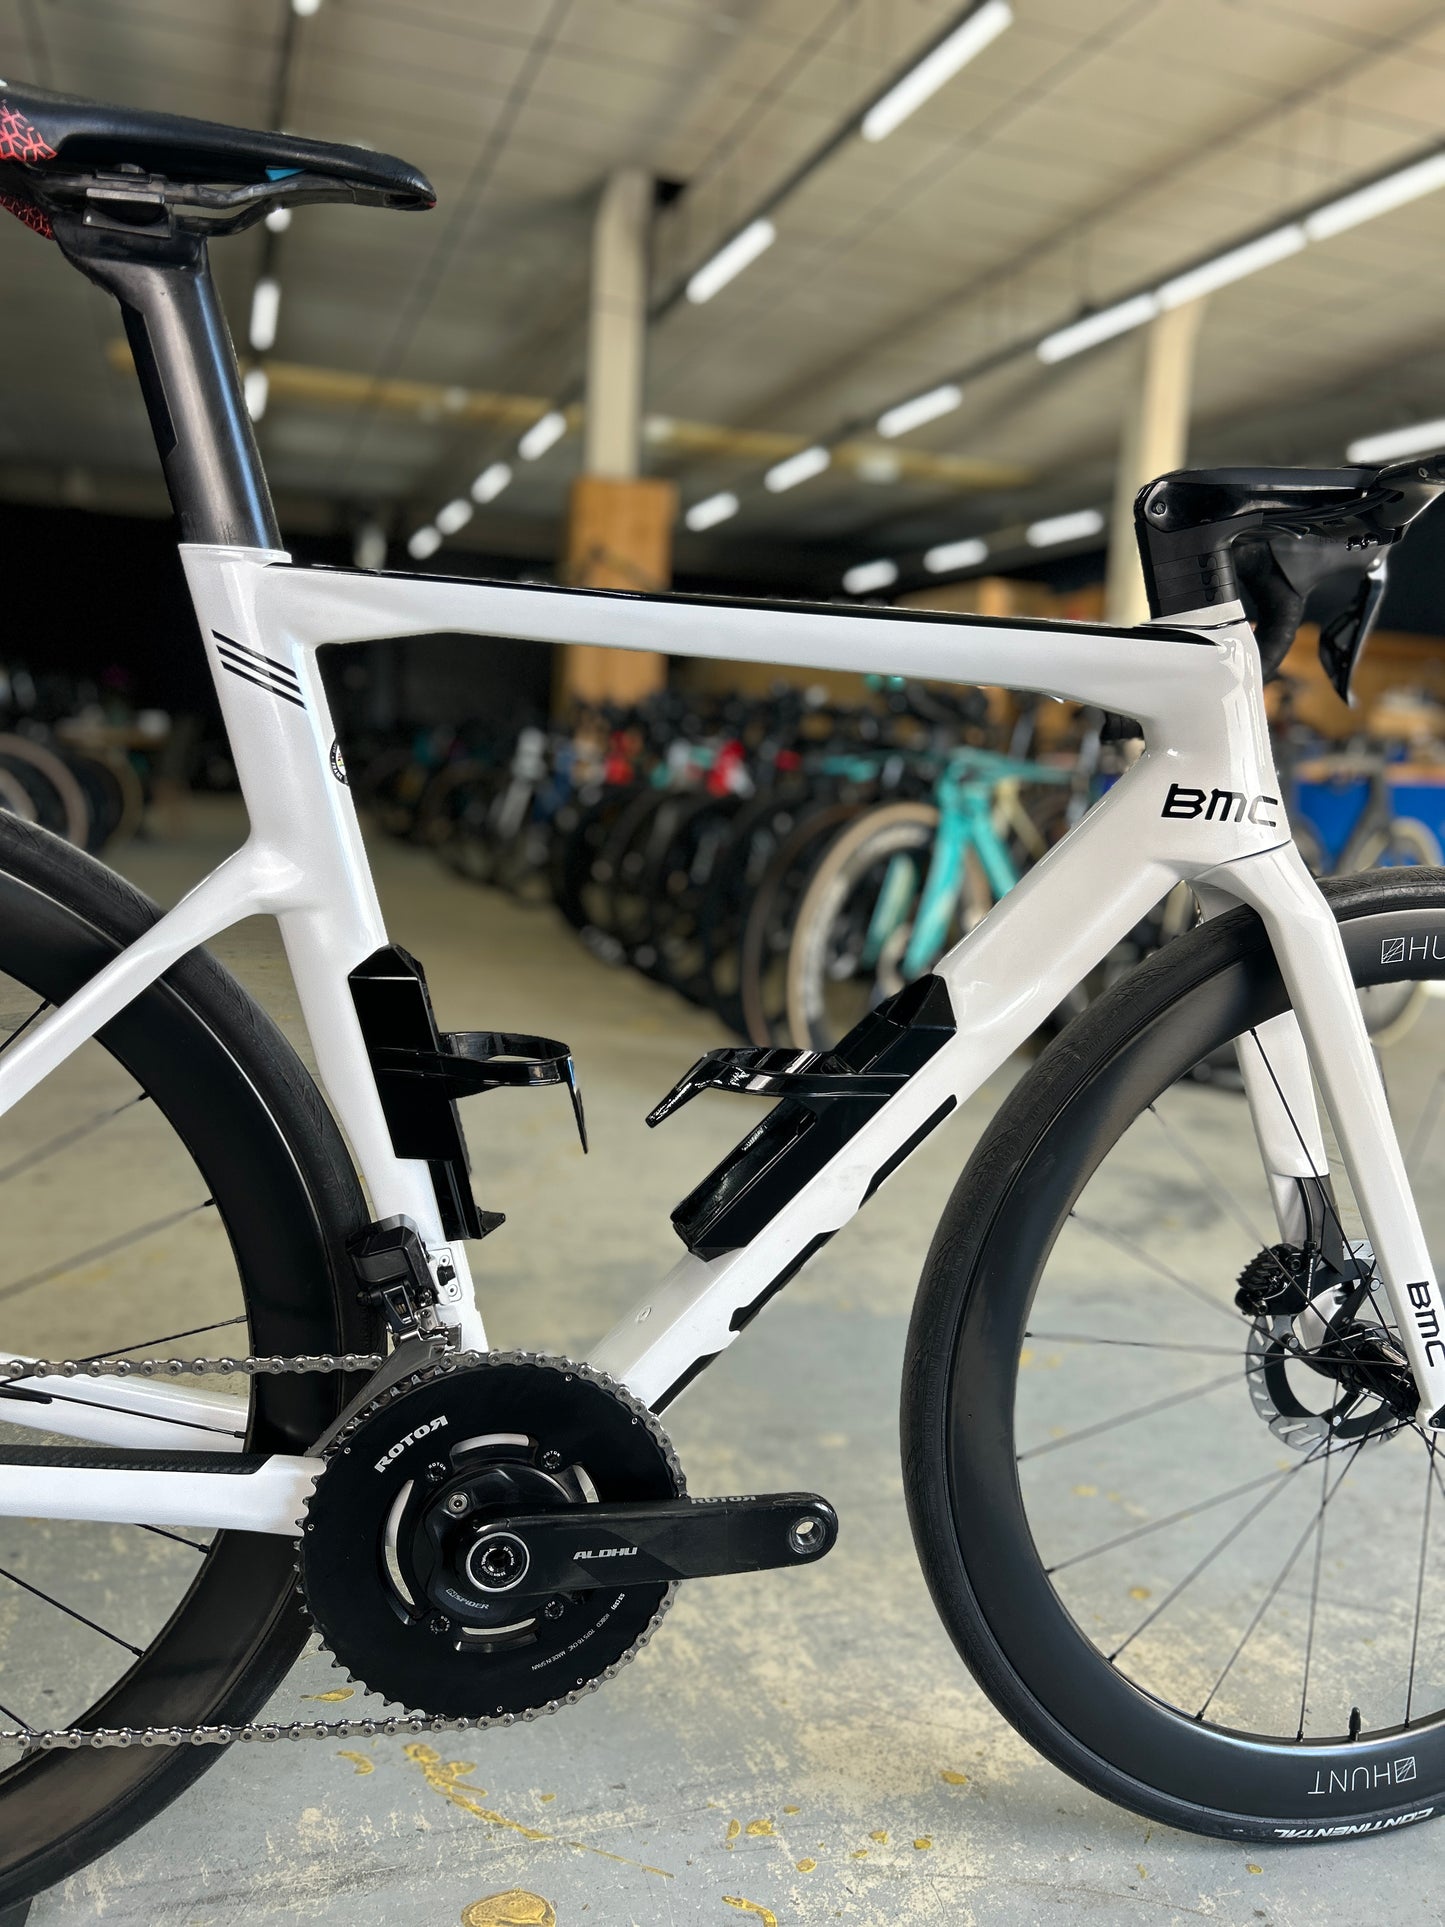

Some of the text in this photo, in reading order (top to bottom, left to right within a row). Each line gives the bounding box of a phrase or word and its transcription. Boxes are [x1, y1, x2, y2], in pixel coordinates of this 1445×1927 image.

[1161, 783, 1278, 827] BMC
[1406, 1281, 1445, 1367] BMC
[374, 1415, 448, 1473] ROTOR
[691, 1495, 756, 1504] ROTOR
[573, 1547, 637, 1560] ALDHU
[1308, 1762, 1391, 1794] HUNT
[1273, 1807, 1434, 1839] CONTINENTAL
